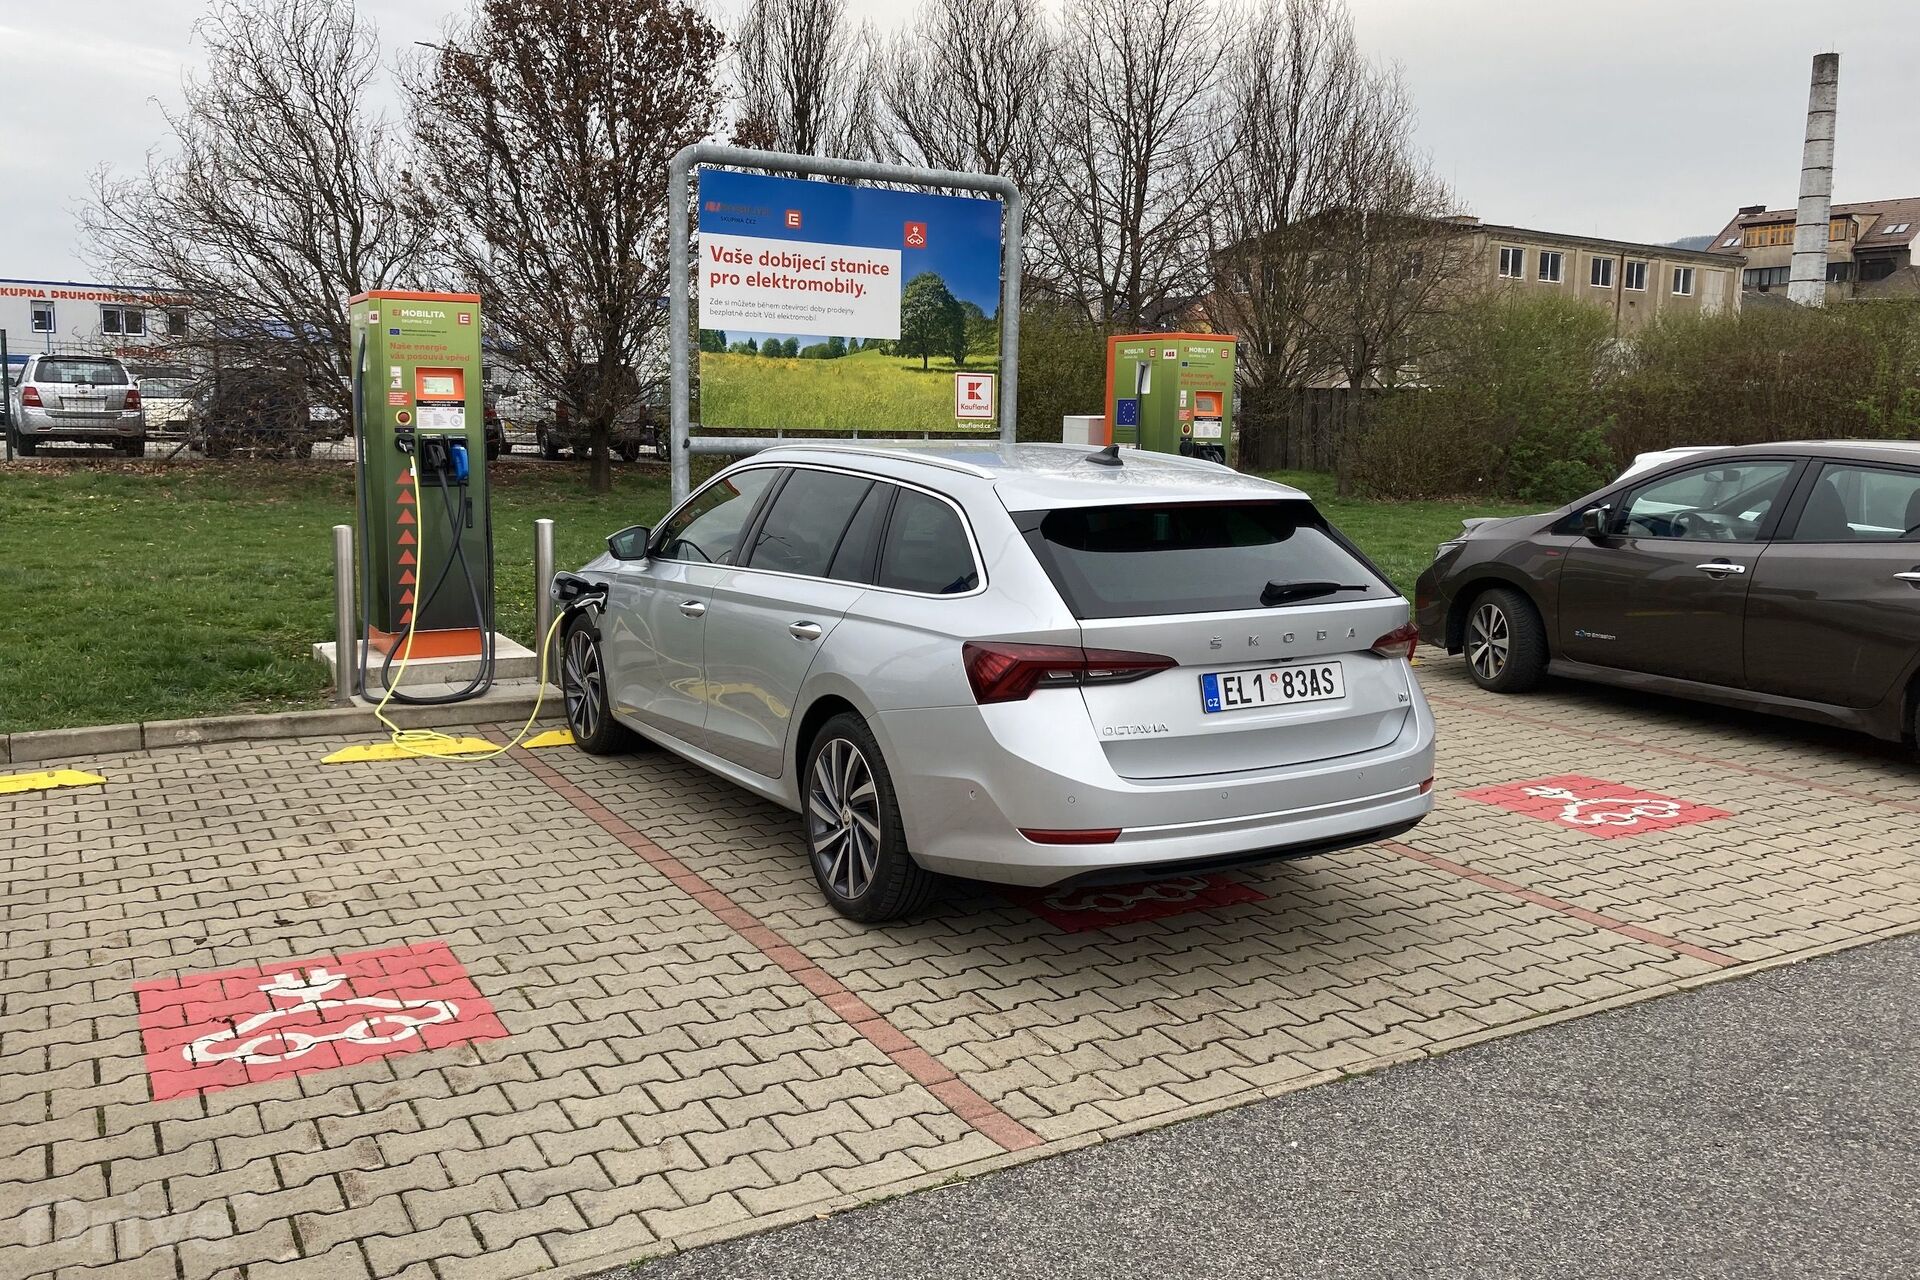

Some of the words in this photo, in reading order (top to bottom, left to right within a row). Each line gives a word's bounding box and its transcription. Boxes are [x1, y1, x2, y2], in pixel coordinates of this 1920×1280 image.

[710, 246, 752, 264] Vaše
[758, 250, 826, 272] dobíjecí
[831, 258, 889, 276] stanice
[710, 272, 740, 288] pro
[746, 271, 866, 298] elektromobily.
[758, 301, 780, 309] během
[810, 304, 826, 314] doby
[1222, 674, 1265, 706] EL1
[1282, 667, 1334, 698] 83AS
[1207, 698, 1219, 707] CZ
[1102, 723, 1168, 736] OCTAVIA
